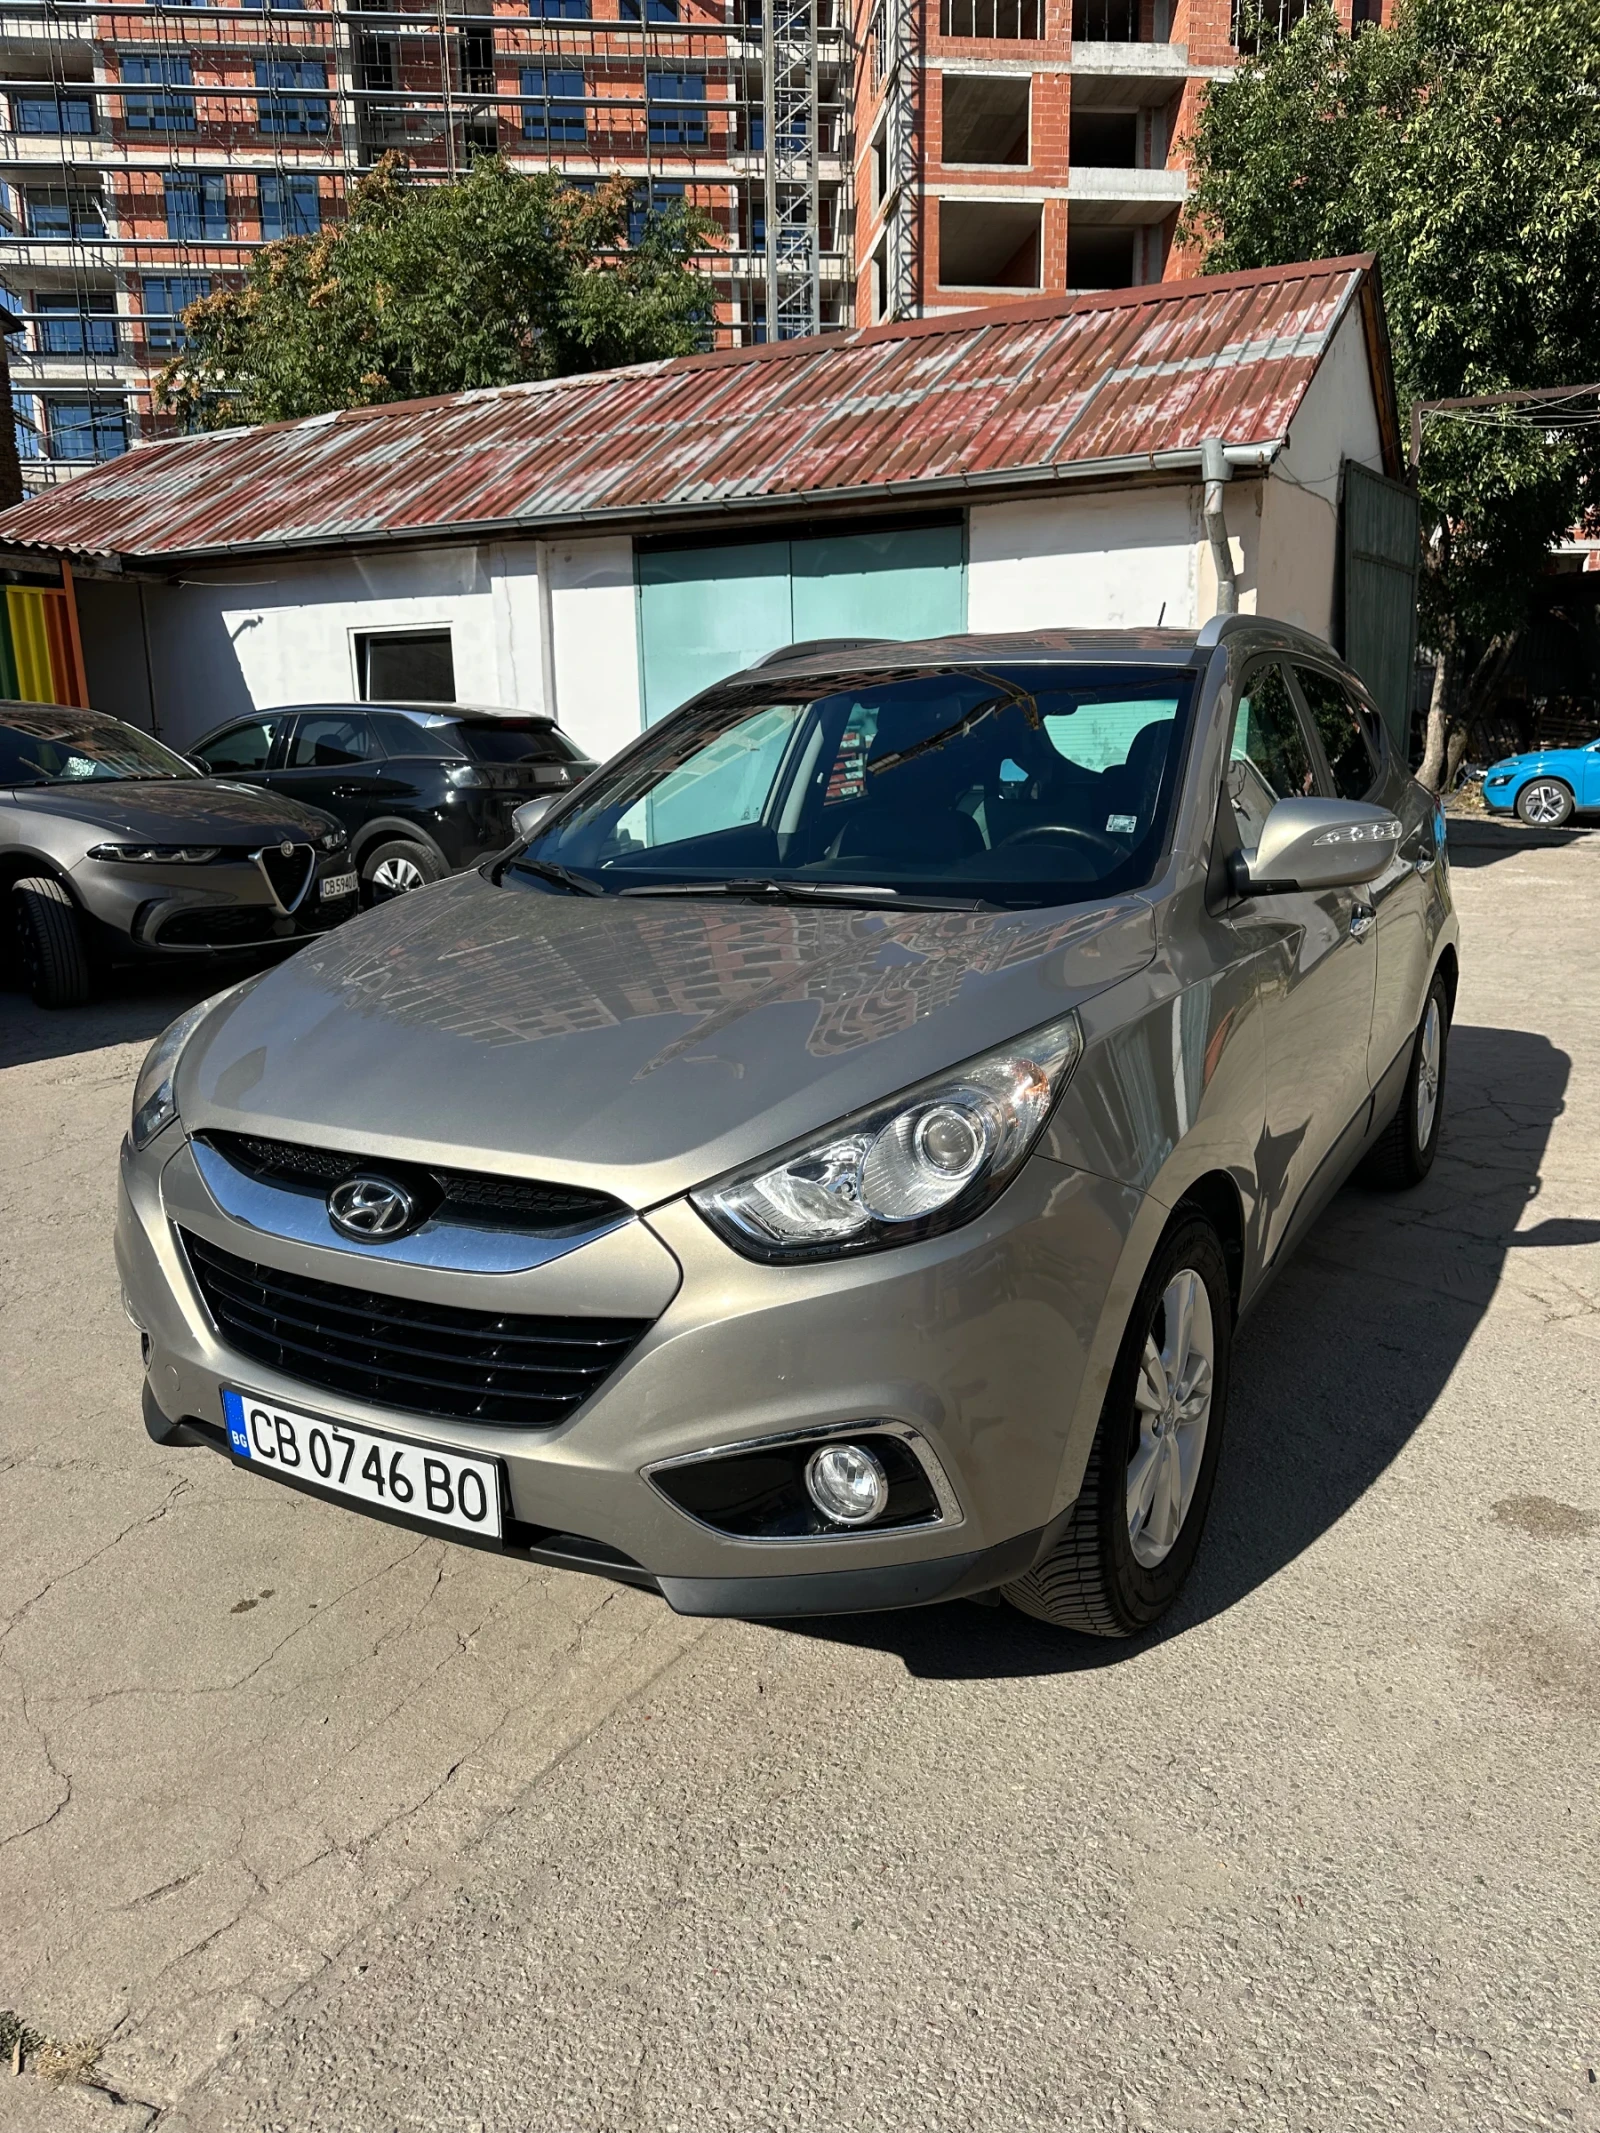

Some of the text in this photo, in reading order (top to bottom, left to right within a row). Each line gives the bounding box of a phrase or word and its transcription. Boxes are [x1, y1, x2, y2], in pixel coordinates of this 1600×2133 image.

[324, 880, 336, 895] CB
[231, 1430, 248, 1448] BG
[250, 1409, 488, 1522] CB 0746 BO
